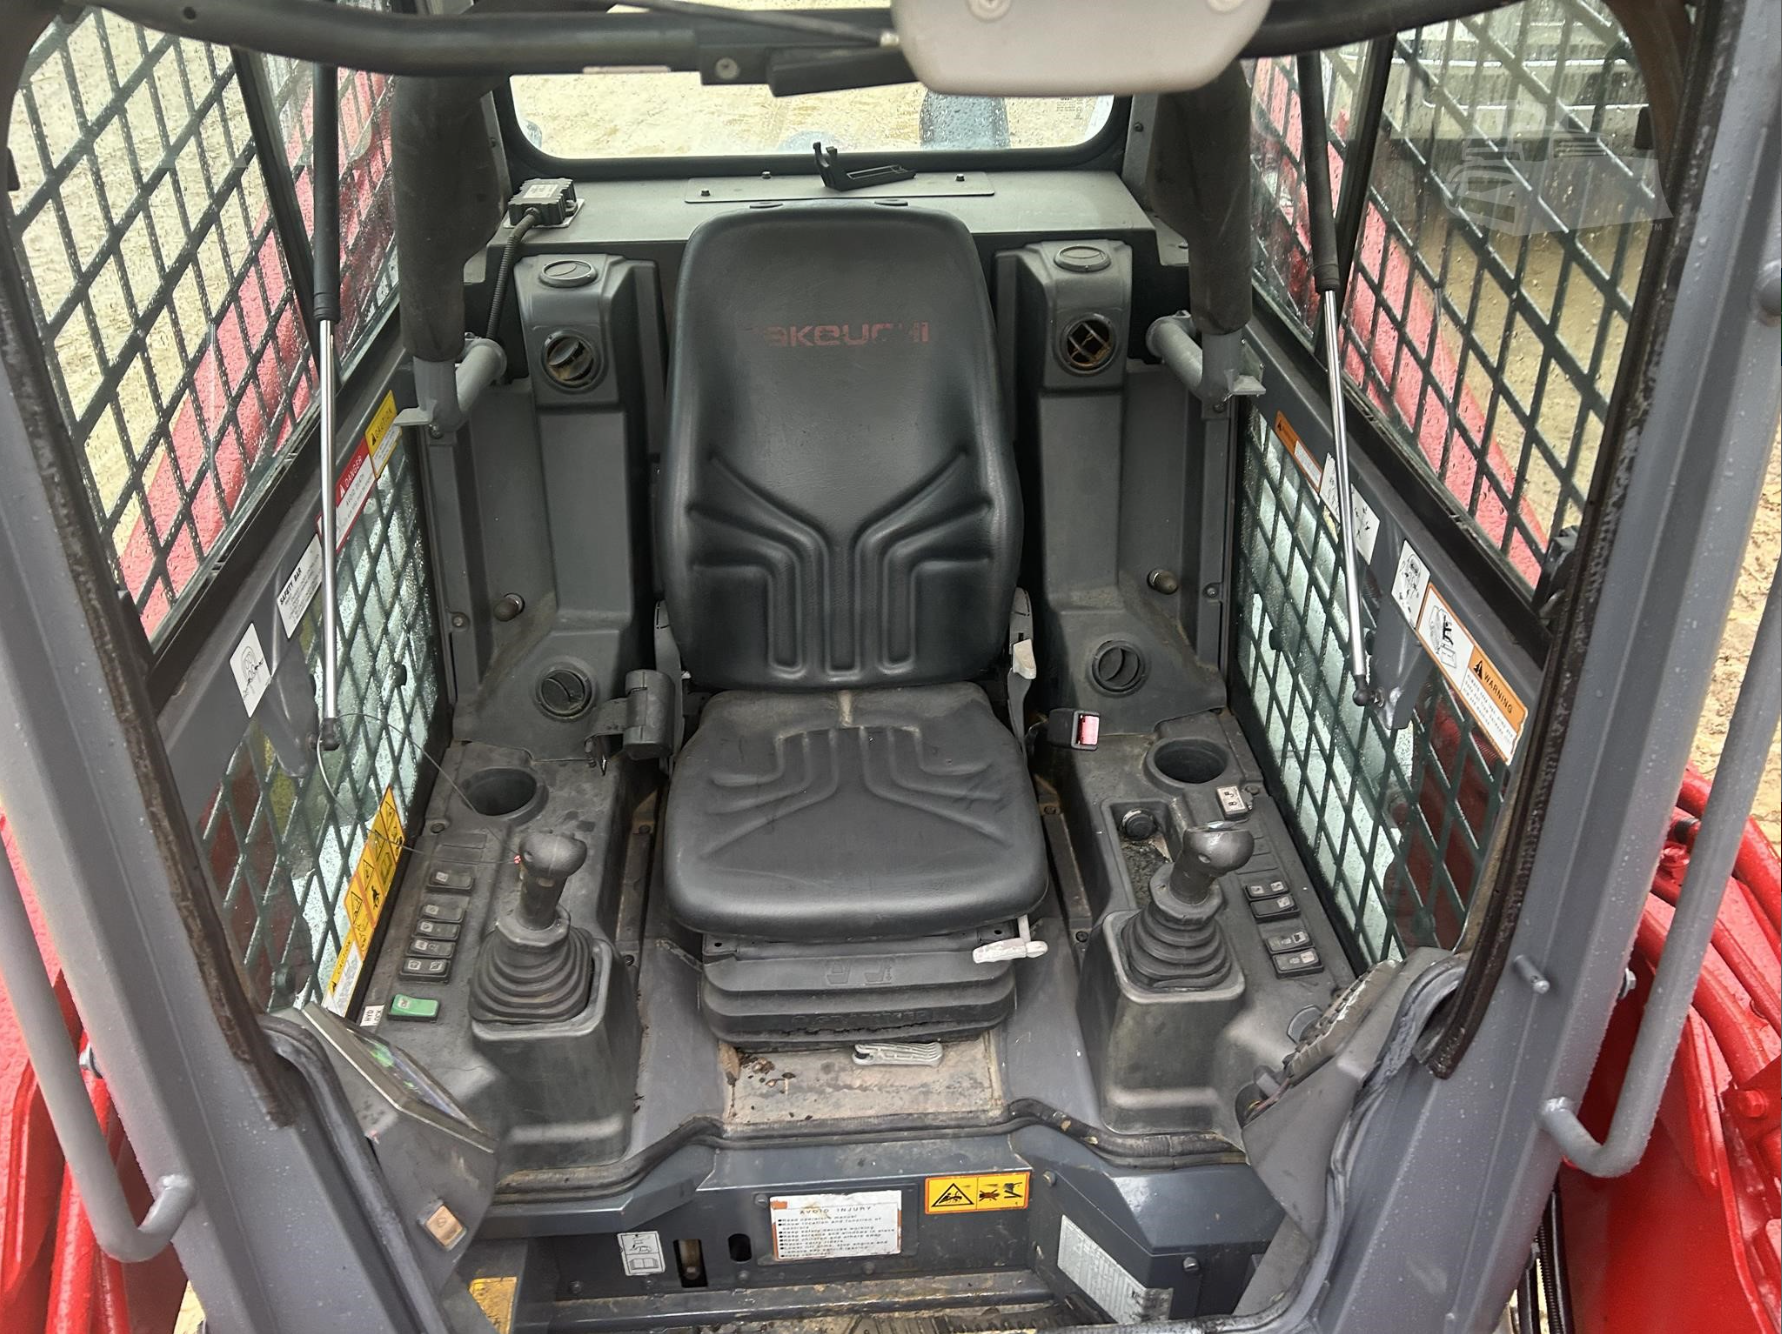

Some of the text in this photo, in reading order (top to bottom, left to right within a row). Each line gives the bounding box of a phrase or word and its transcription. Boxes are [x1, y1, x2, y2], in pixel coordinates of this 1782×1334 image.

[345, 455, 362, 488] DANGER
[280, 567, 302, 606] SAFETY BAR
[1484, 672, 1514, 714] WARNING
[364, 1009, 374, 1022] HYD
